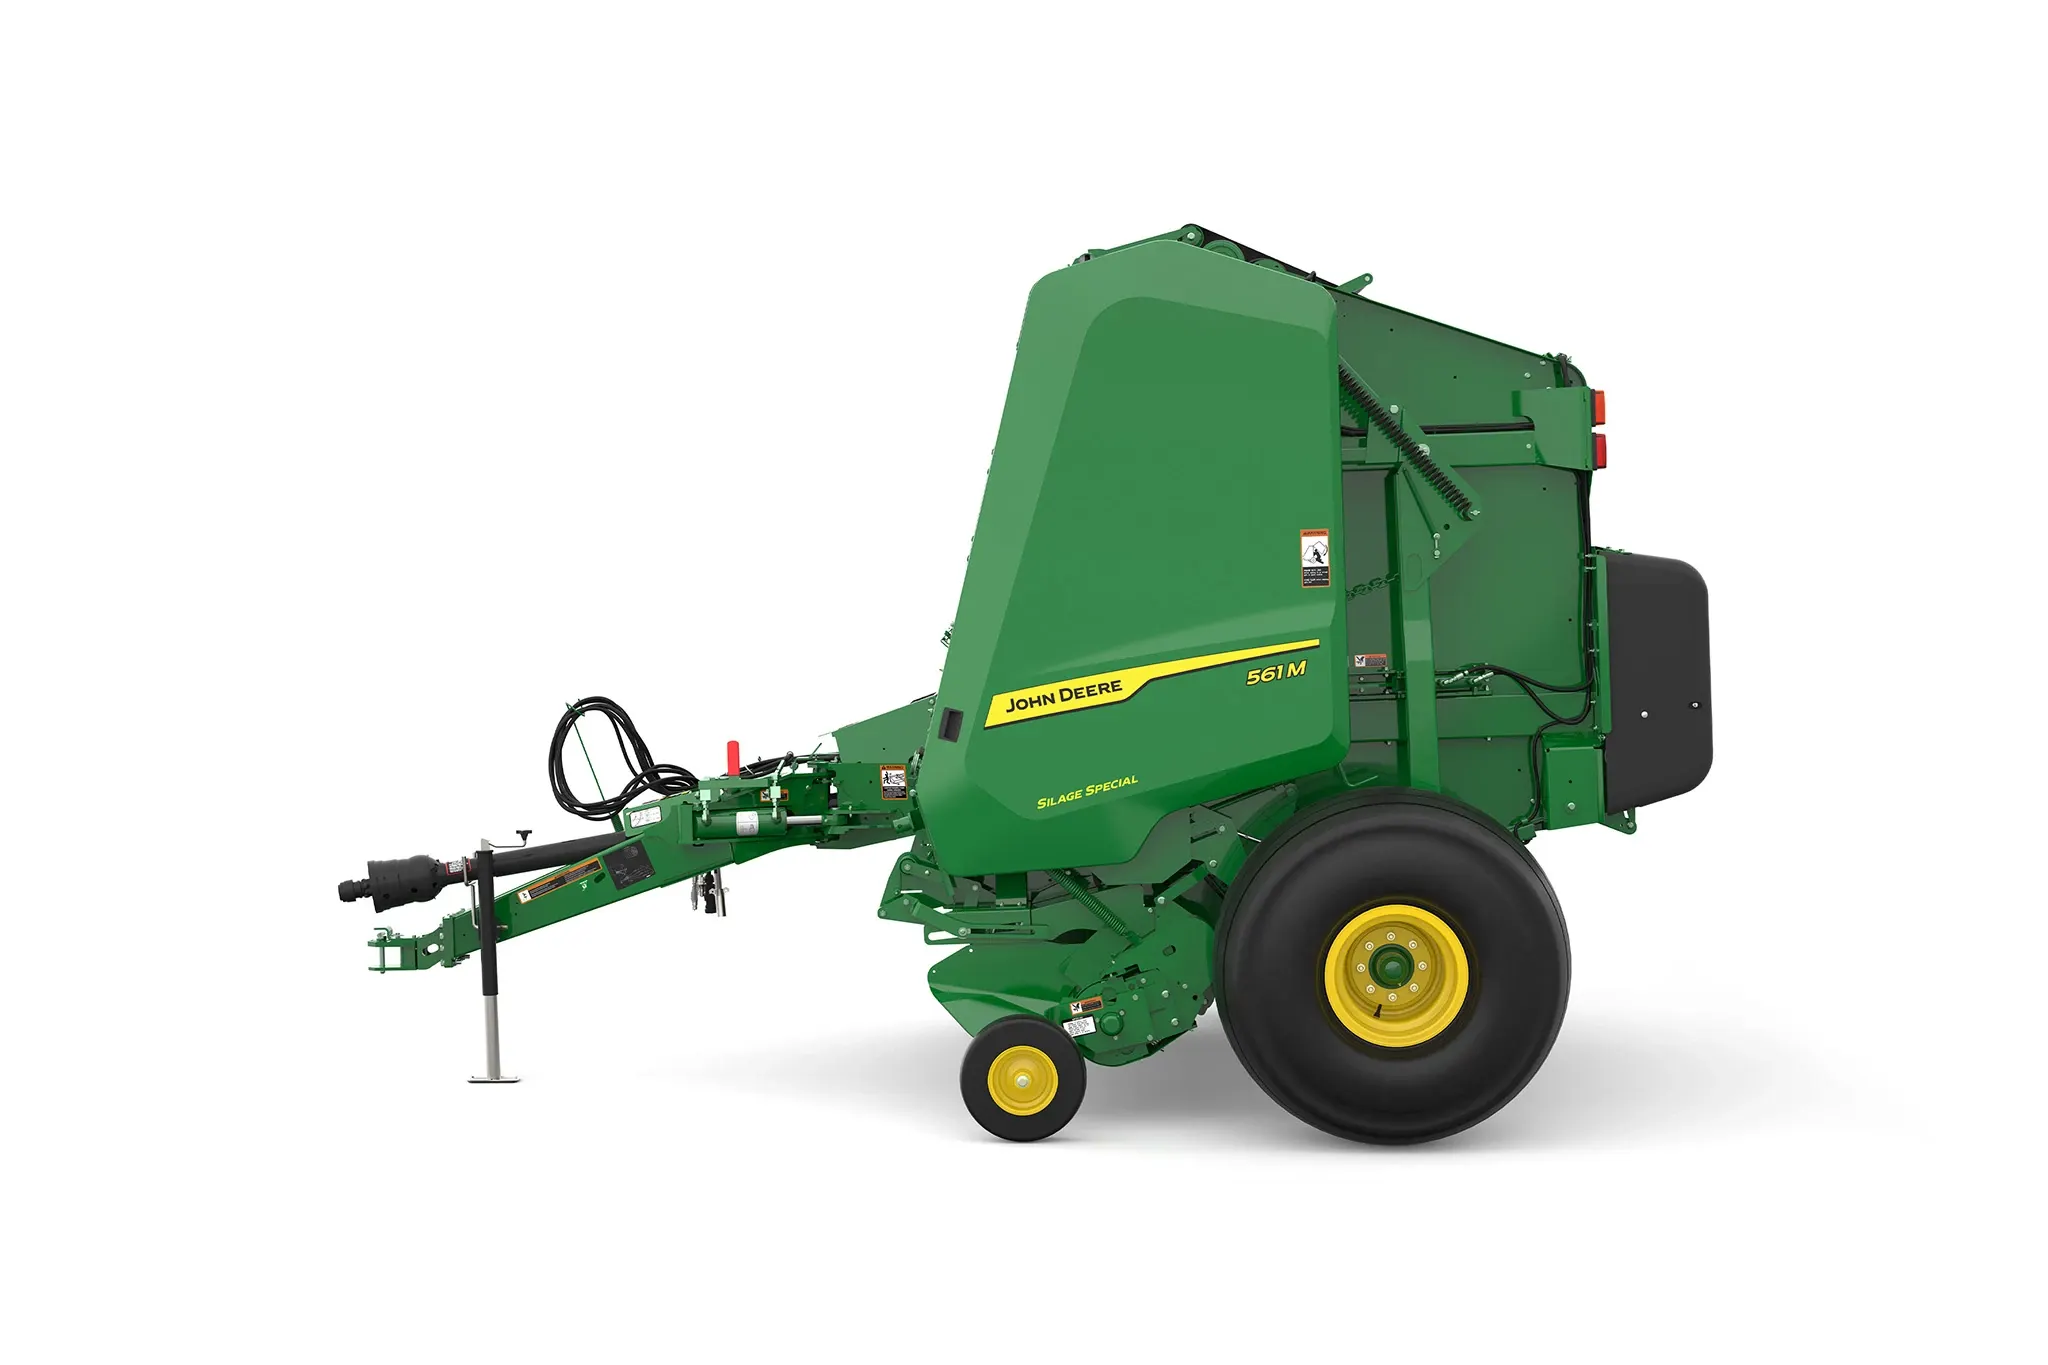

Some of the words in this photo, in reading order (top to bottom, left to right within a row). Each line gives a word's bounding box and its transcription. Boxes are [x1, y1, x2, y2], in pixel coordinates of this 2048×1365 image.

[1006, 693, 1056, 713] JOHN
[1059, 680, 1123, 702] DEERE
[1037, 789, 1083, 809] SILAGE
[1085, 775, 1138, 796] SPECIAL
